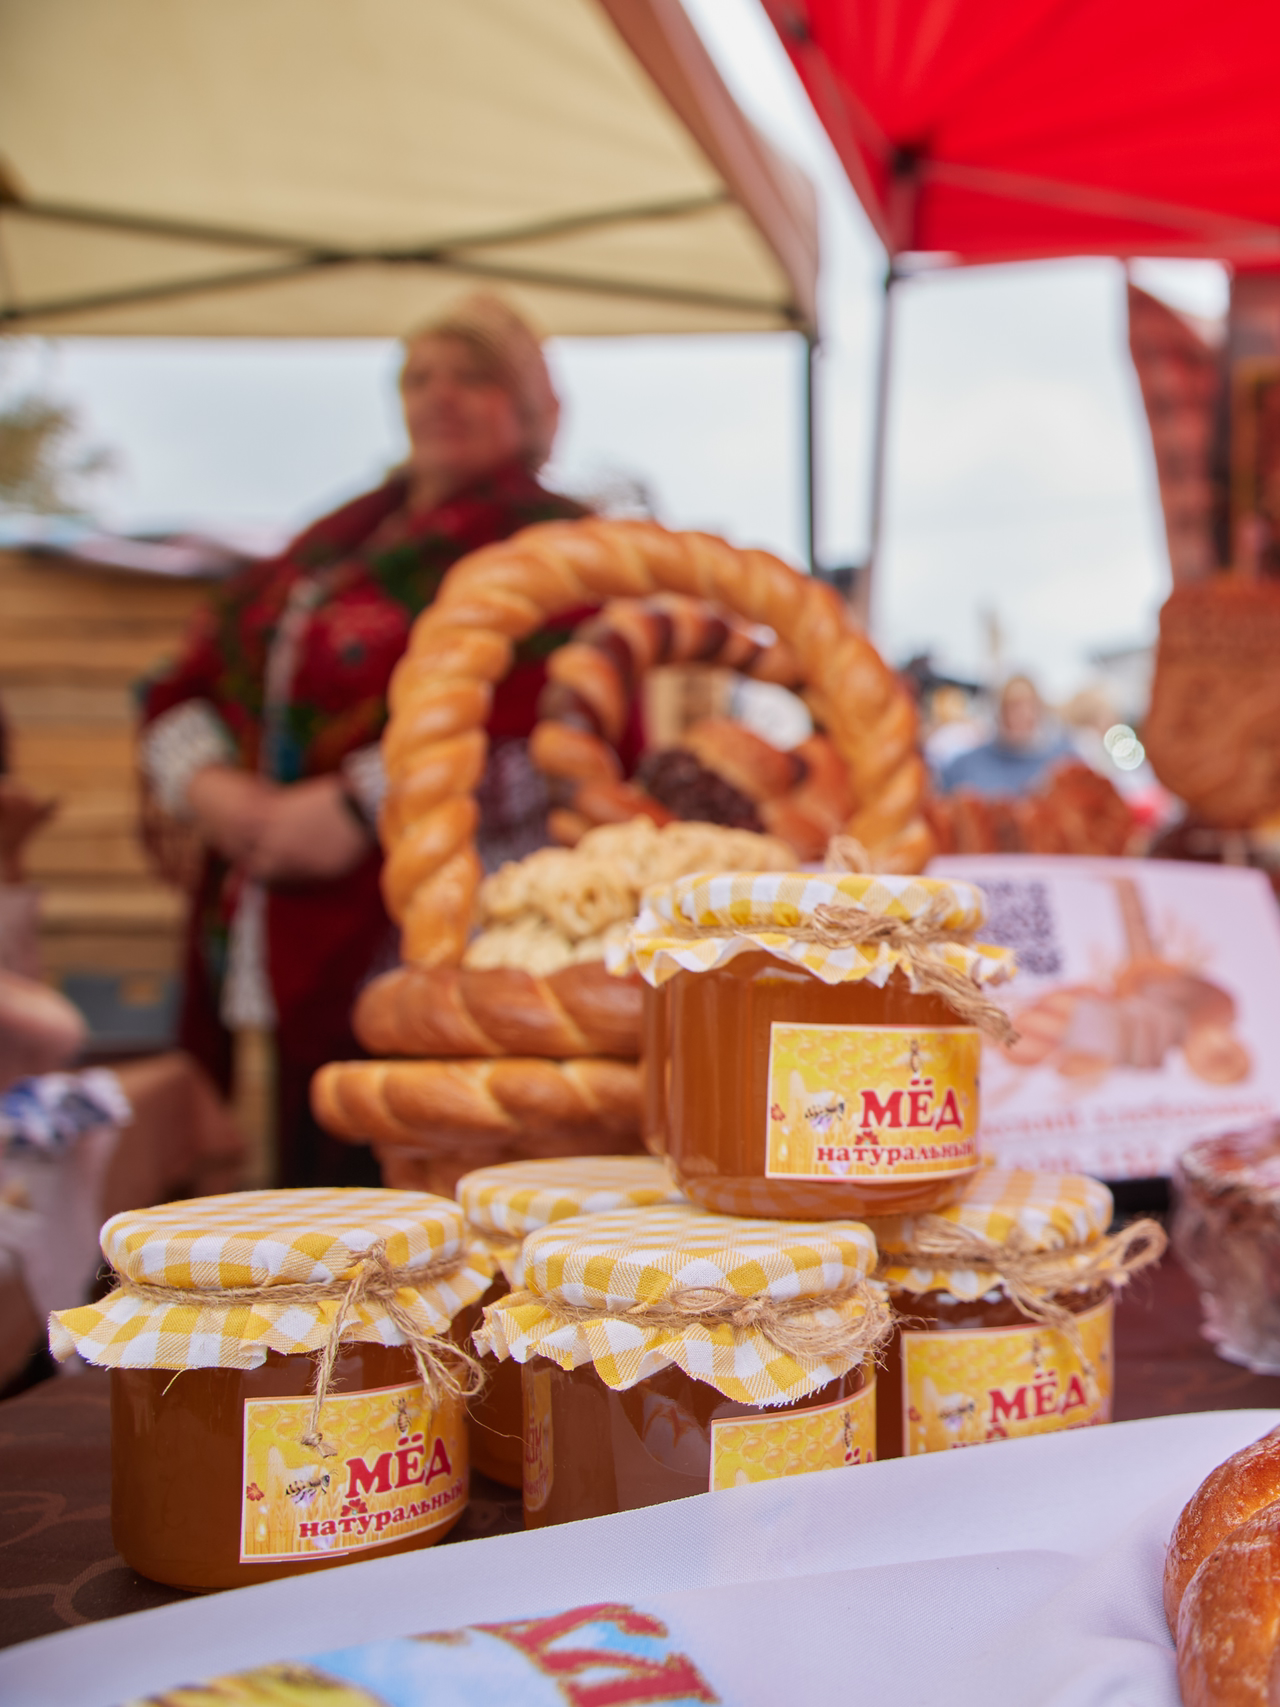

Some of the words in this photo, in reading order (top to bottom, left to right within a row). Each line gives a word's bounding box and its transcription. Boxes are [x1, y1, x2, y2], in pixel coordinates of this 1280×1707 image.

[859, 1079, 961, 1132] МЁД
[817, 1138, 974, 1166] натуральный
[989, 1371, 1087, 1423] МЁД
[345, 1433, 451, 1498] МЁД
[299, 1479, 463, 1538] натуральный
